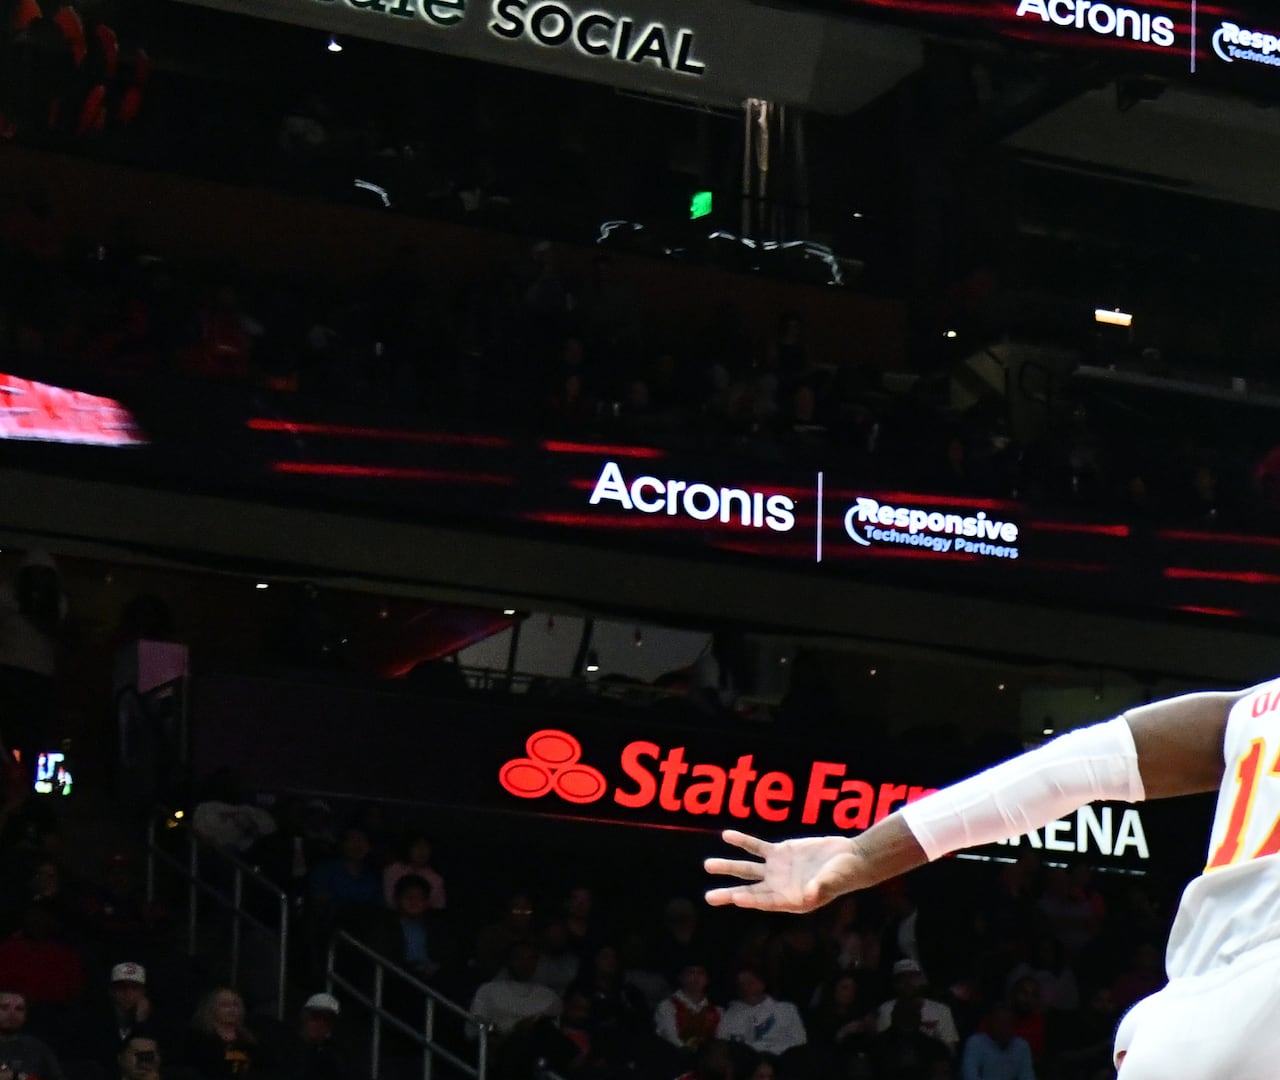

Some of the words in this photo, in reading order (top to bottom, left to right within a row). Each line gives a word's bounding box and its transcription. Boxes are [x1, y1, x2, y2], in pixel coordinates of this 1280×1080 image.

[488, 0, 706, 75] SOCIAL
[1016, 0, 1175, 47] Acronis
[588, 461, 796, 532] Acronis
[856, 497, 1019, 543] Responsive
[863, 525, 952, 553] Technology
[954, 538, 1019, 560] Partners
[613, 740, 795, 822] State
[997, 805, 1150, 858] ENA
